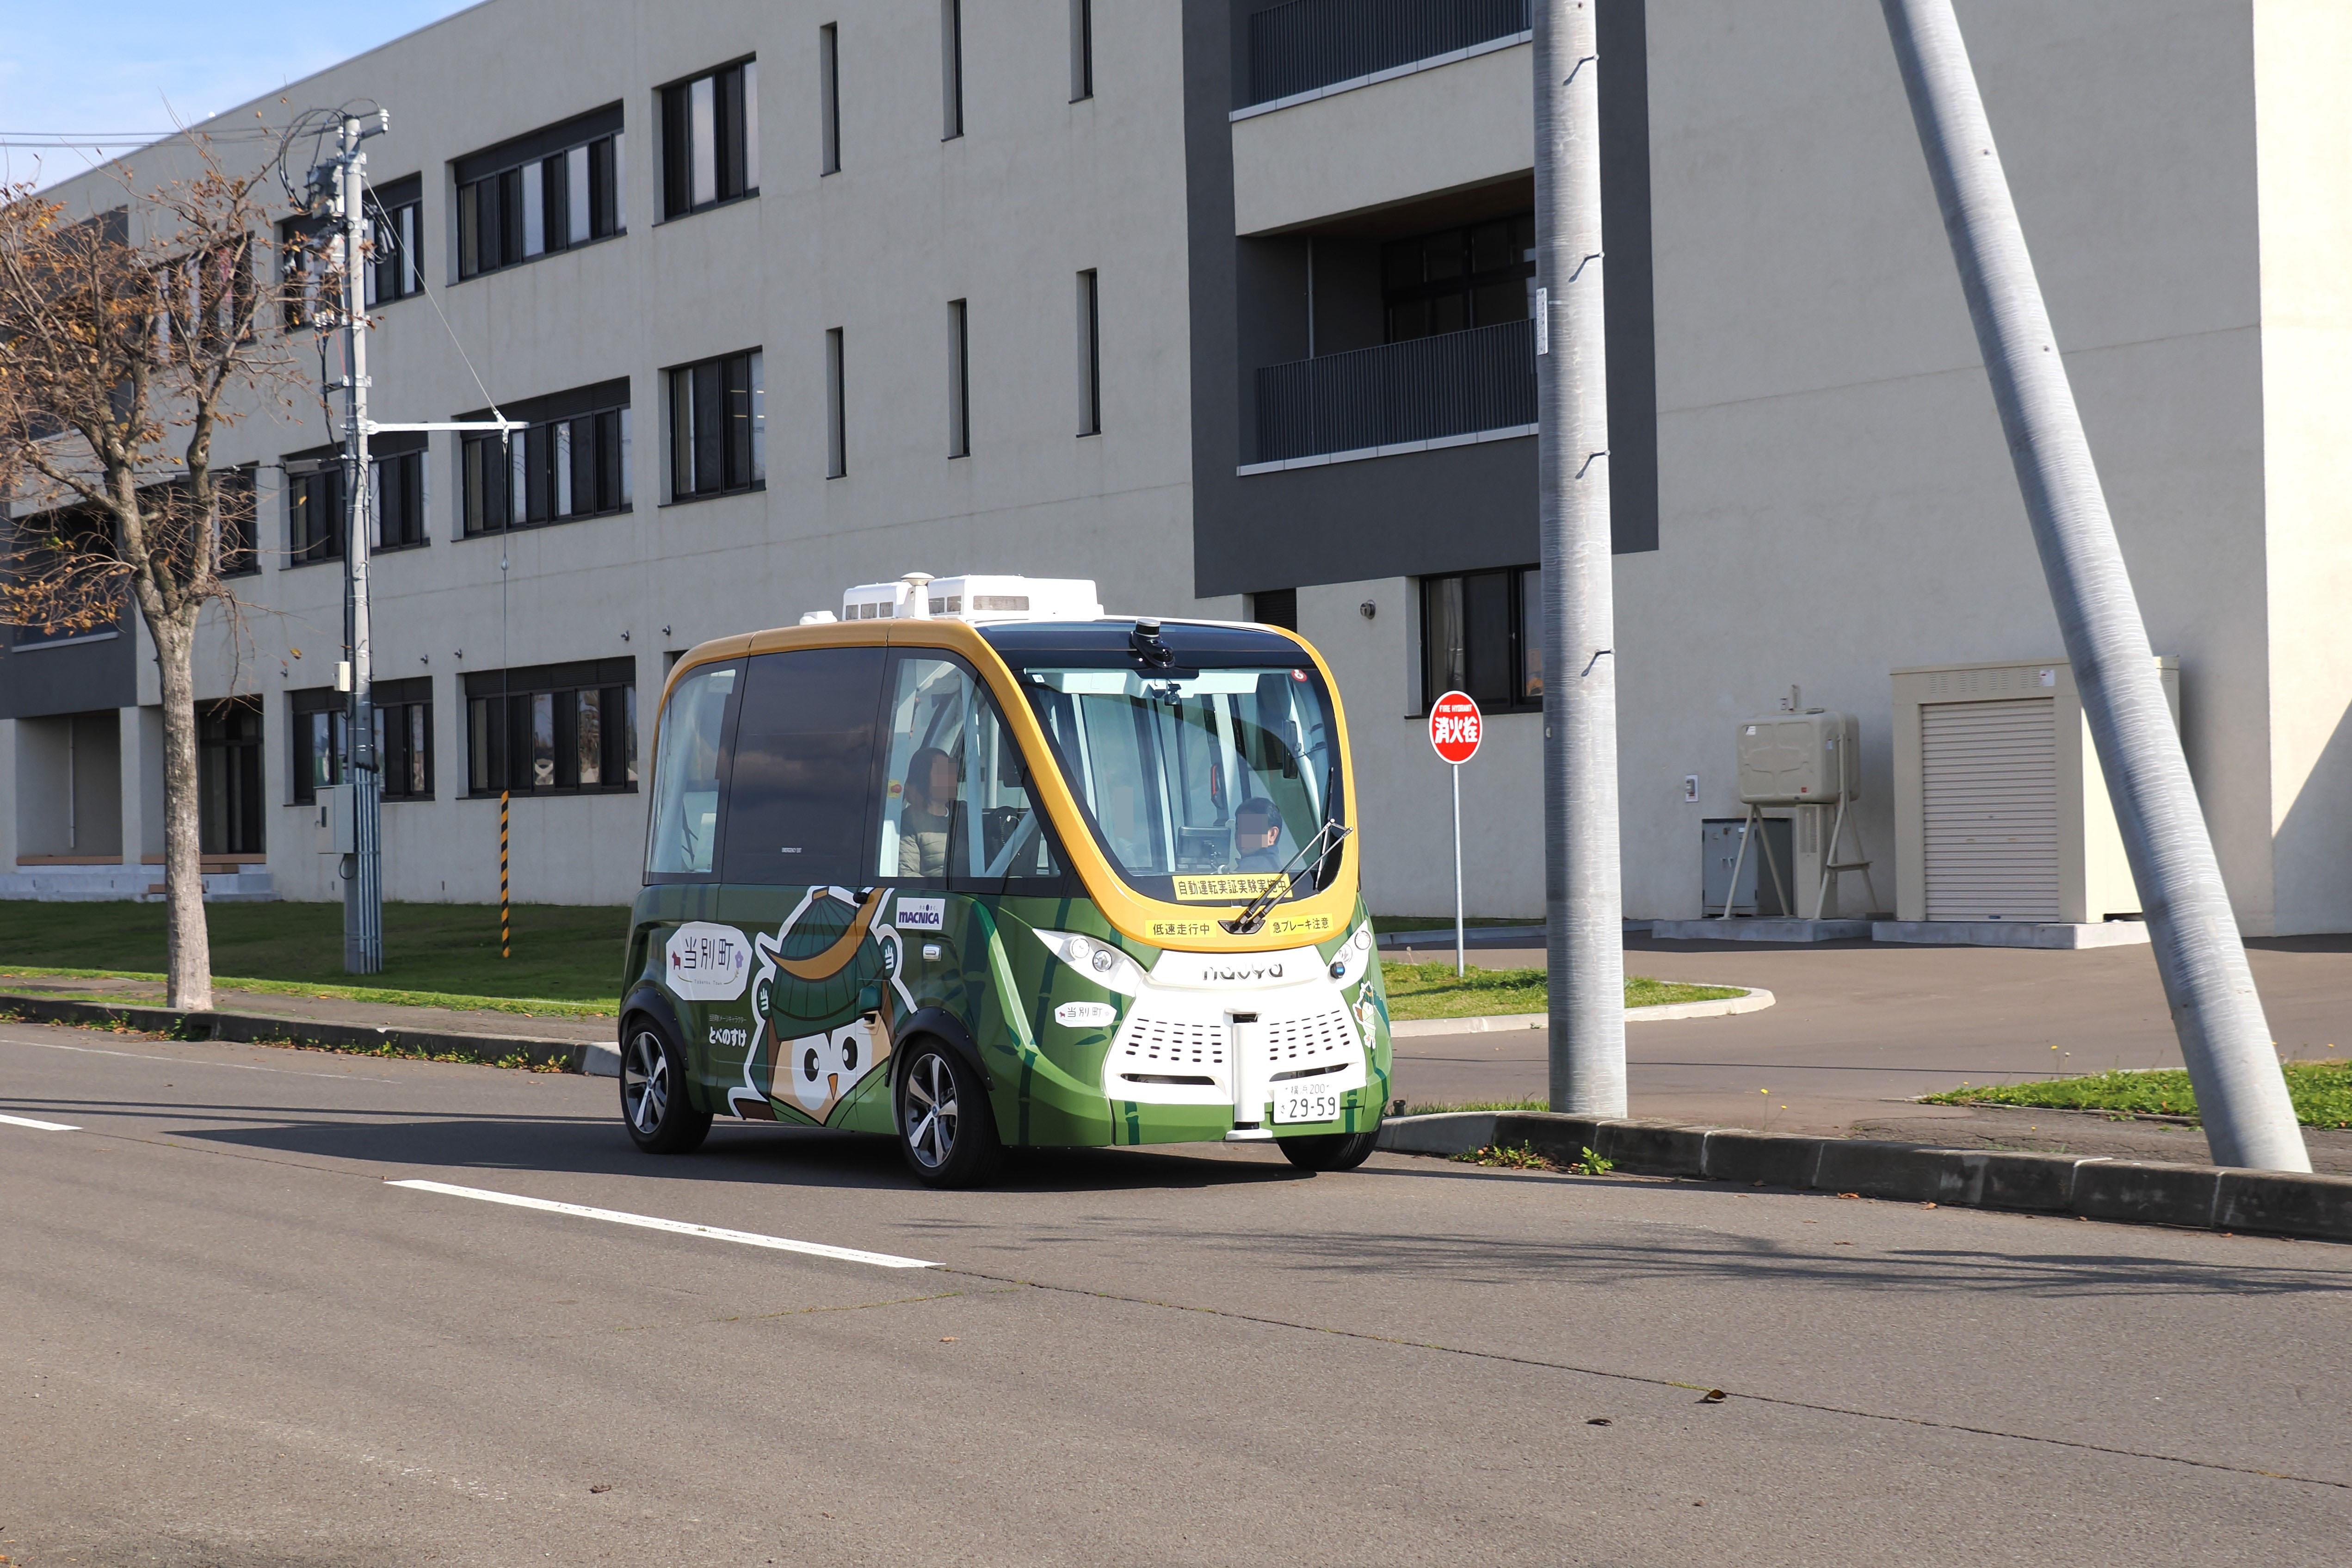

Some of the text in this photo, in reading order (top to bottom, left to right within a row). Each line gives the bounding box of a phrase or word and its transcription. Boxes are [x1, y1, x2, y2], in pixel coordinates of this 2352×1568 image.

[1435, 716, 1478, 744] 消火栓
[1153, 923, 1210, 935] 低速走行中
[1273, 917, 1329, 933] 急ブレーキ注意
[684, 937, 734, 970] 当別町
[1203, 963, 1283, 981] navya
[1068, 1007, 1103, 1017] 当別町
[709, 1026, 747, 1047] とべのすけ
[1290, 1097, 1335, 1118] 29-59
